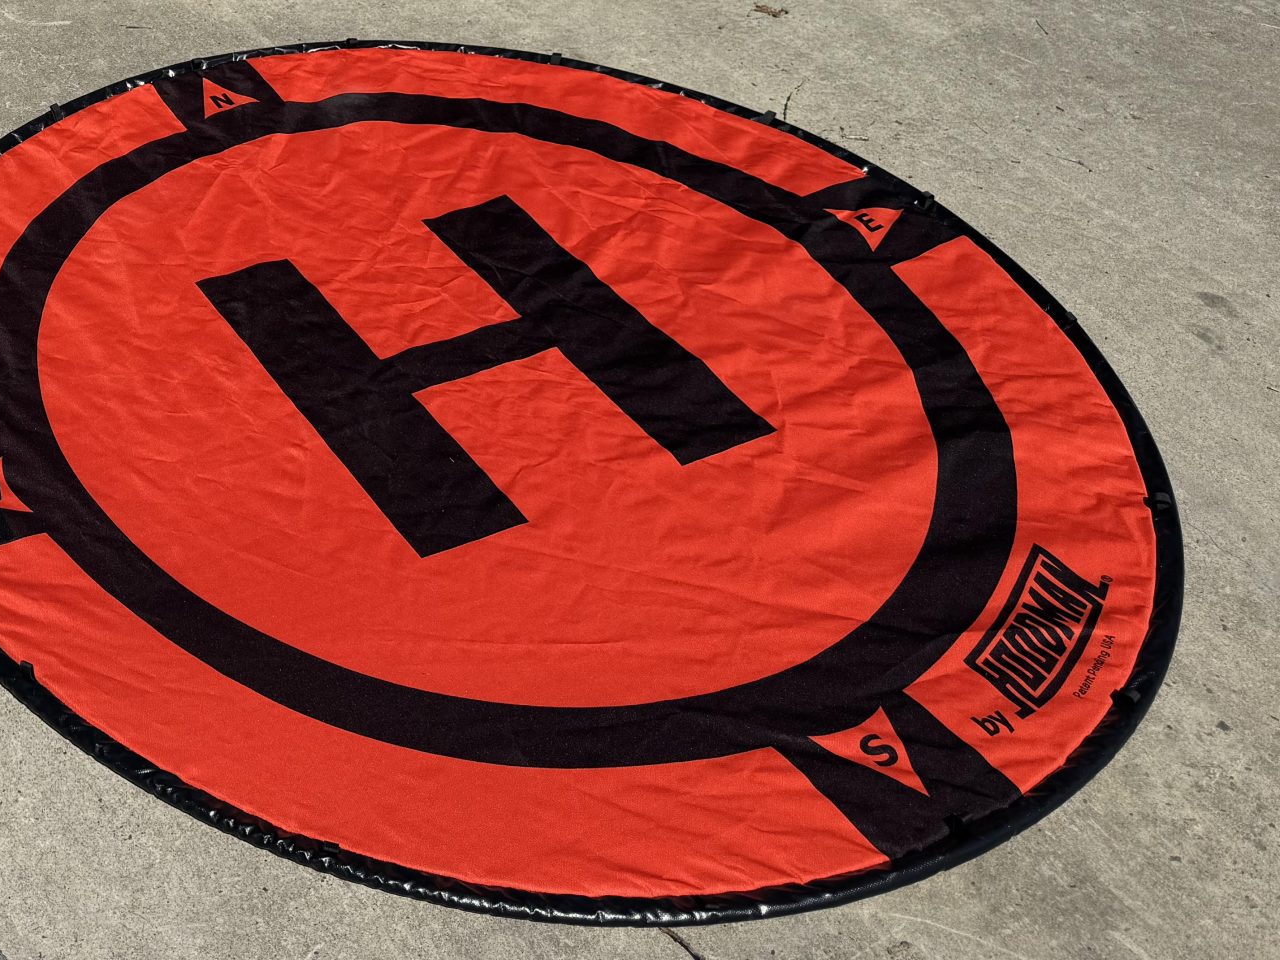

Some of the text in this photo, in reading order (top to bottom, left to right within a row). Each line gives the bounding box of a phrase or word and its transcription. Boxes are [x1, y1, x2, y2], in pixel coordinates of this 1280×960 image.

[209, 92, 235, 109] N
[853, 212, 885, 233] E
[195, 194, 777, 558] H
[1072, 634, 1116, 698] Patent Pending USA
[970, 710, 1015, 737] by
[859, 733, 899, 767] S
